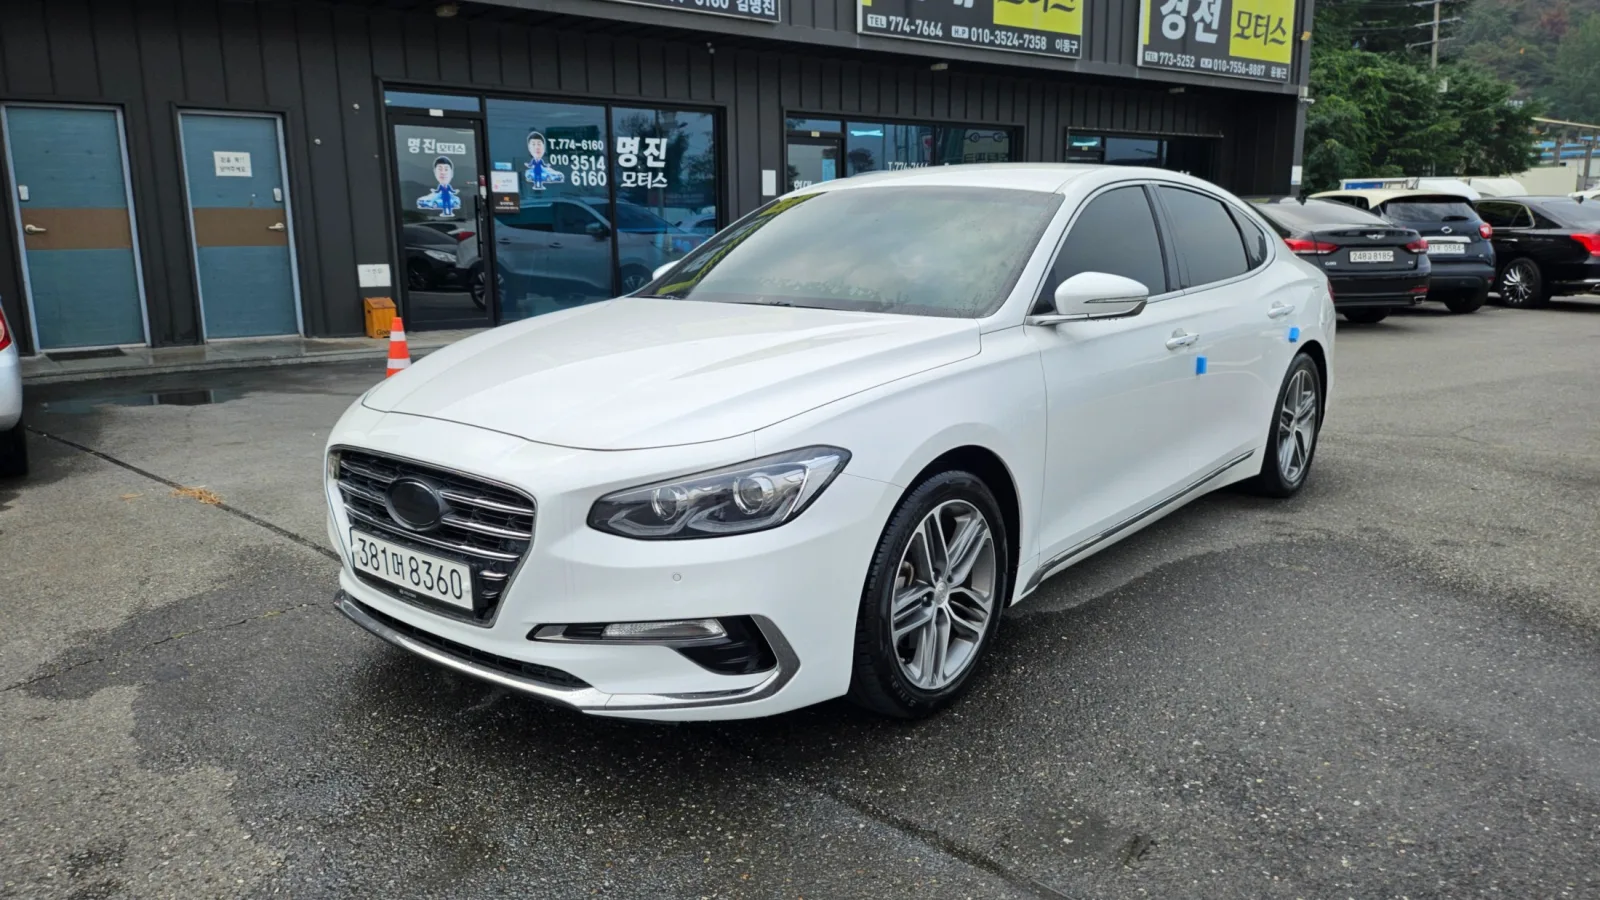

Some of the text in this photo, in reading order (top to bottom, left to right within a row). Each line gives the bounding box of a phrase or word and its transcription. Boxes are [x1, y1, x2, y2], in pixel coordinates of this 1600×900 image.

[867, 15, 886, 28] TEL
[889, 16, 943, 37] 774-7664
[953, 26, 968, 38] H.P
[971, 27, 1047, 50] 010-3524-7358
[1233, 10, 1288, 46] 모터스
[1159, 51, 1195, 68] 773-5252
[407, 138, 466, 154] 명진 모터스
[548, 139, 604, 151] T.774-6160
[616, 137, 668, 168] 명진
[550, 154, 606, 171] 010 3514
[571, 171, 607, 187] 6160
[621, 172, 668, 189] 모터스
[358, 538, 463, 600] 381머8360
